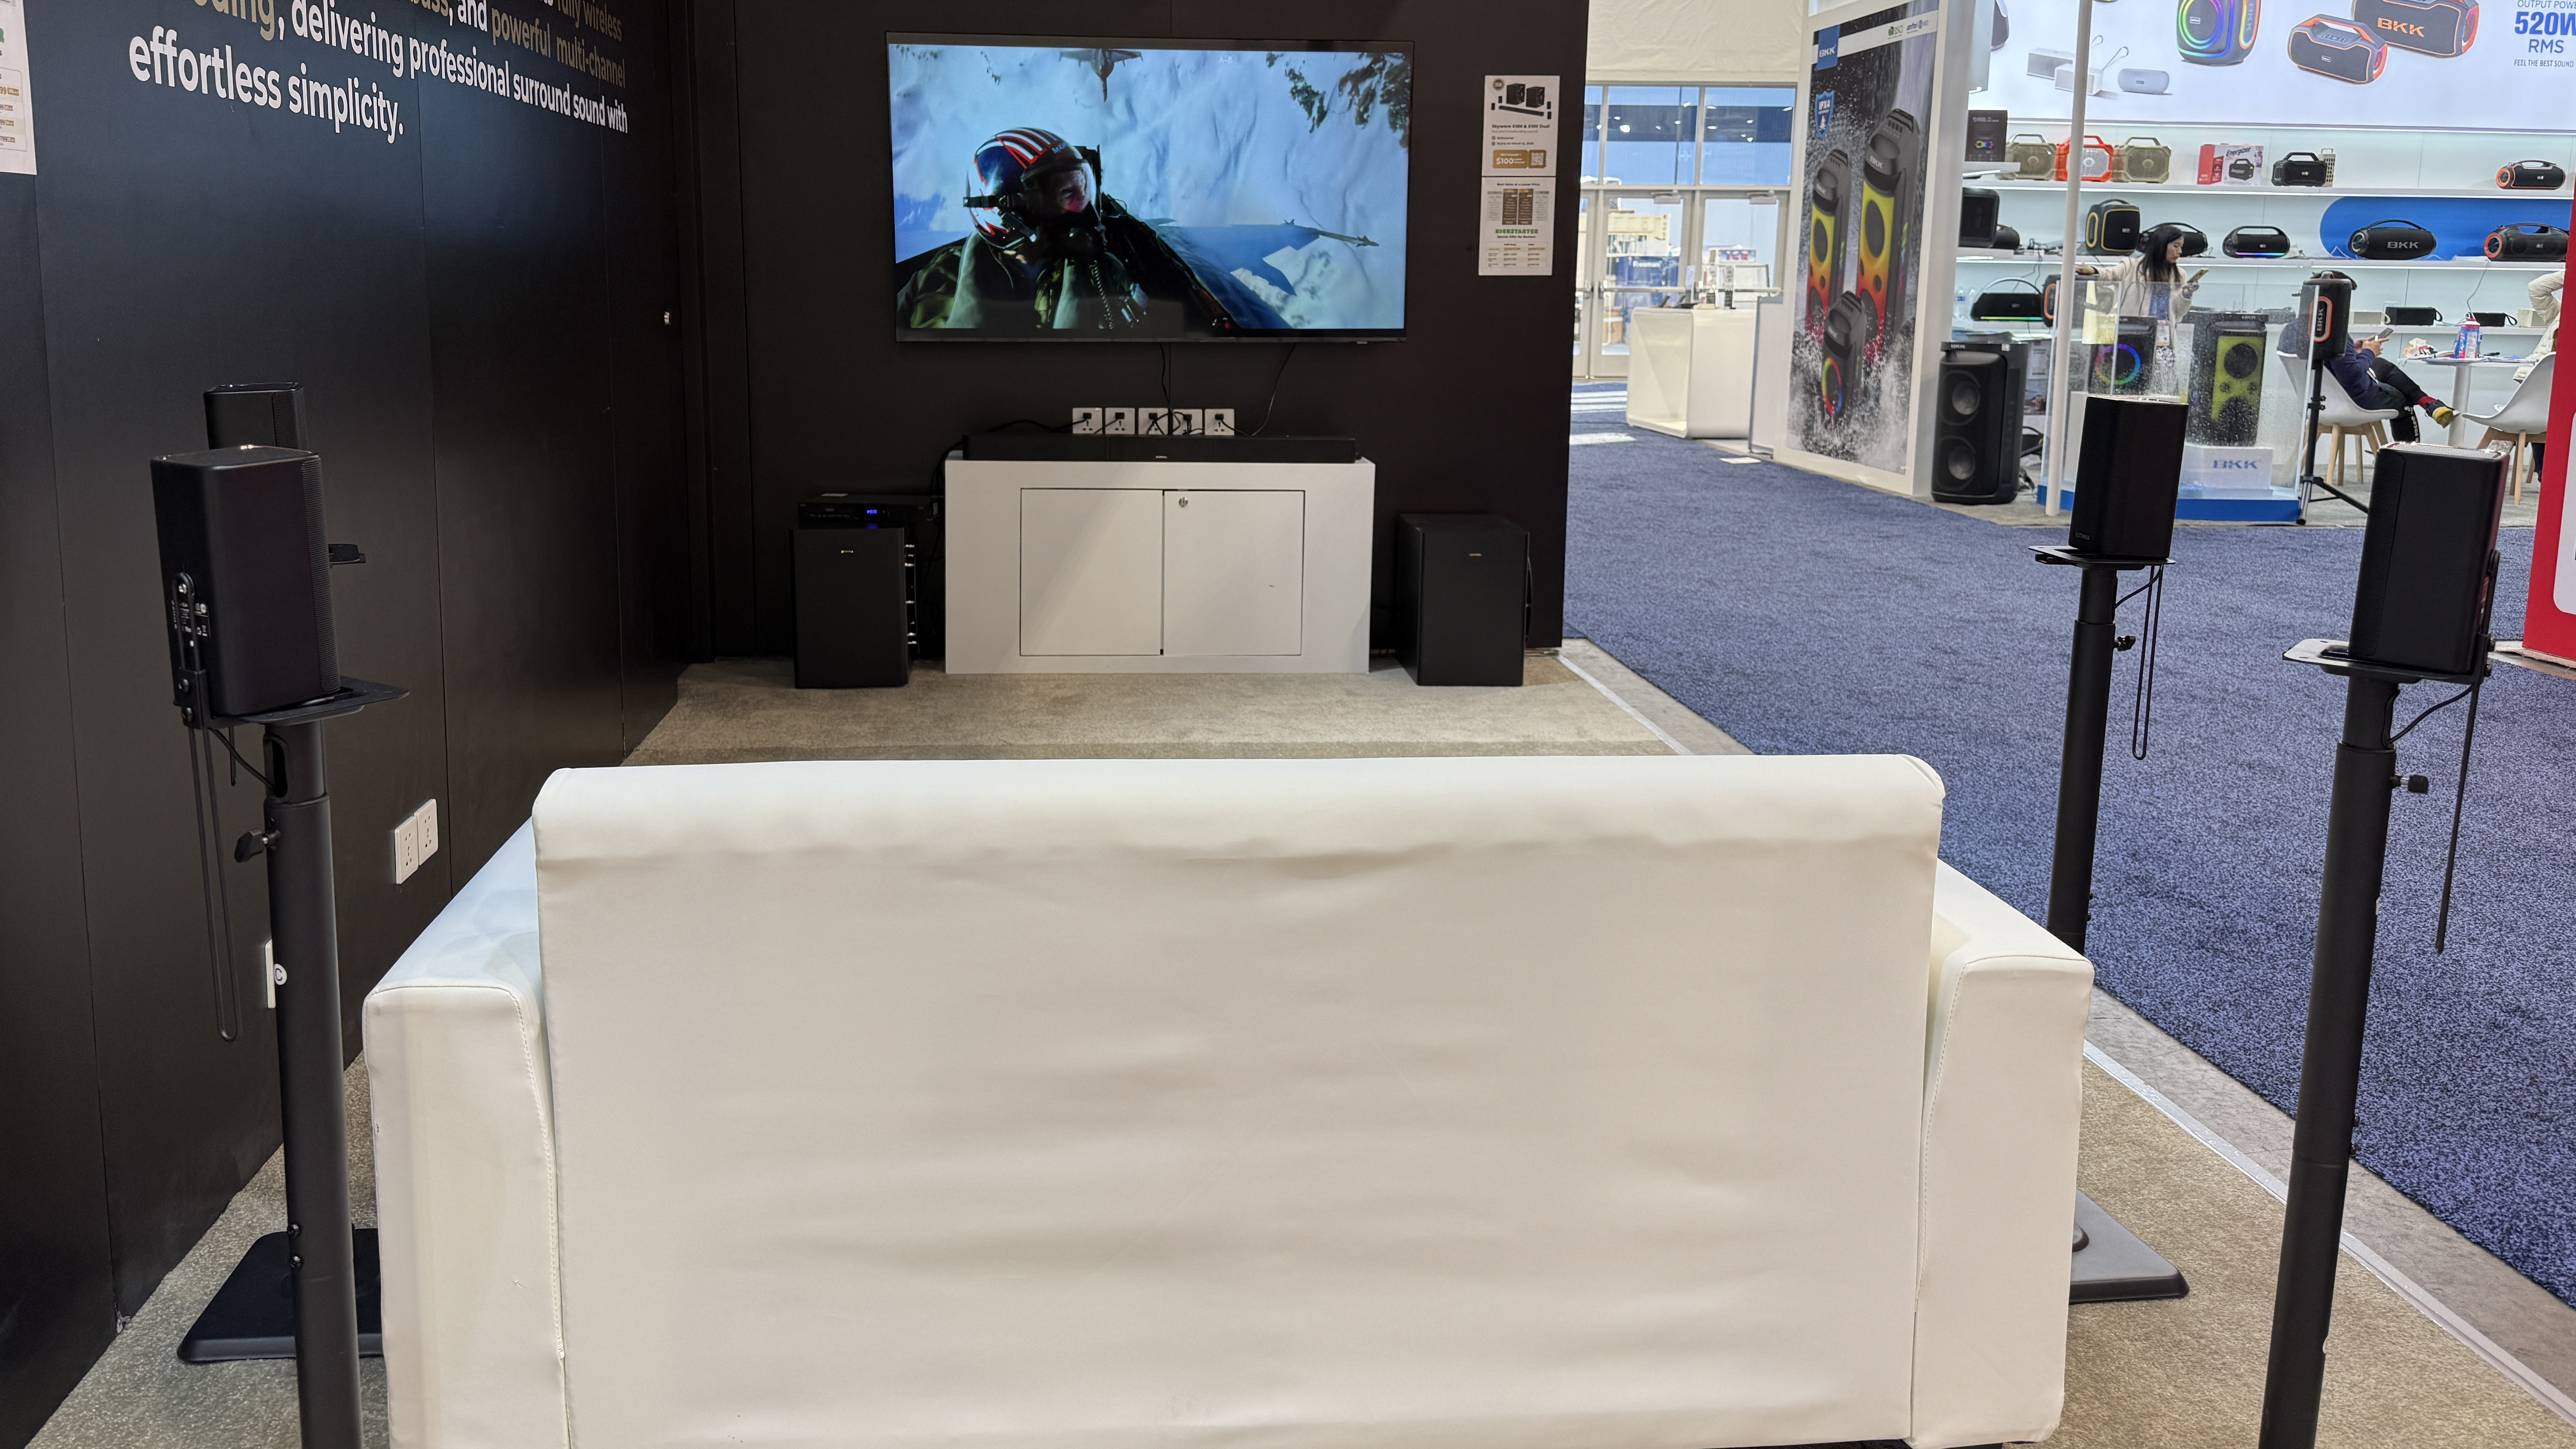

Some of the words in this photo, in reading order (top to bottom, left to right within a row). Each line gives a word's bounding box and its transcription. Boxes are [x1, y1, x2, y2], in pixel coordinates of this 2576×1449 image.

[2518, 0, 2552, 8] OUTPUT
[583, 0, 622, 41] wireless
[2378, 17, 2425, 37] BKK
[458, 0, 488, 32] and
[492, 7, 551, 57] powerful
[557, 36, 625, 88] multi-channel
[2528, 39, 2564, 54] RMS
[291, 0, 403, 77] delivering
[409, 37, 510, 97] professional
[513, 73, 571, 116] surround
[573, 94, 606, 126] sound
[607, 99, 628, 133] with
[129, 26, 282, 109] effortless
[288, 63, 403, 144] simplicity.
[2213, 460, 2258, 469] BKK
